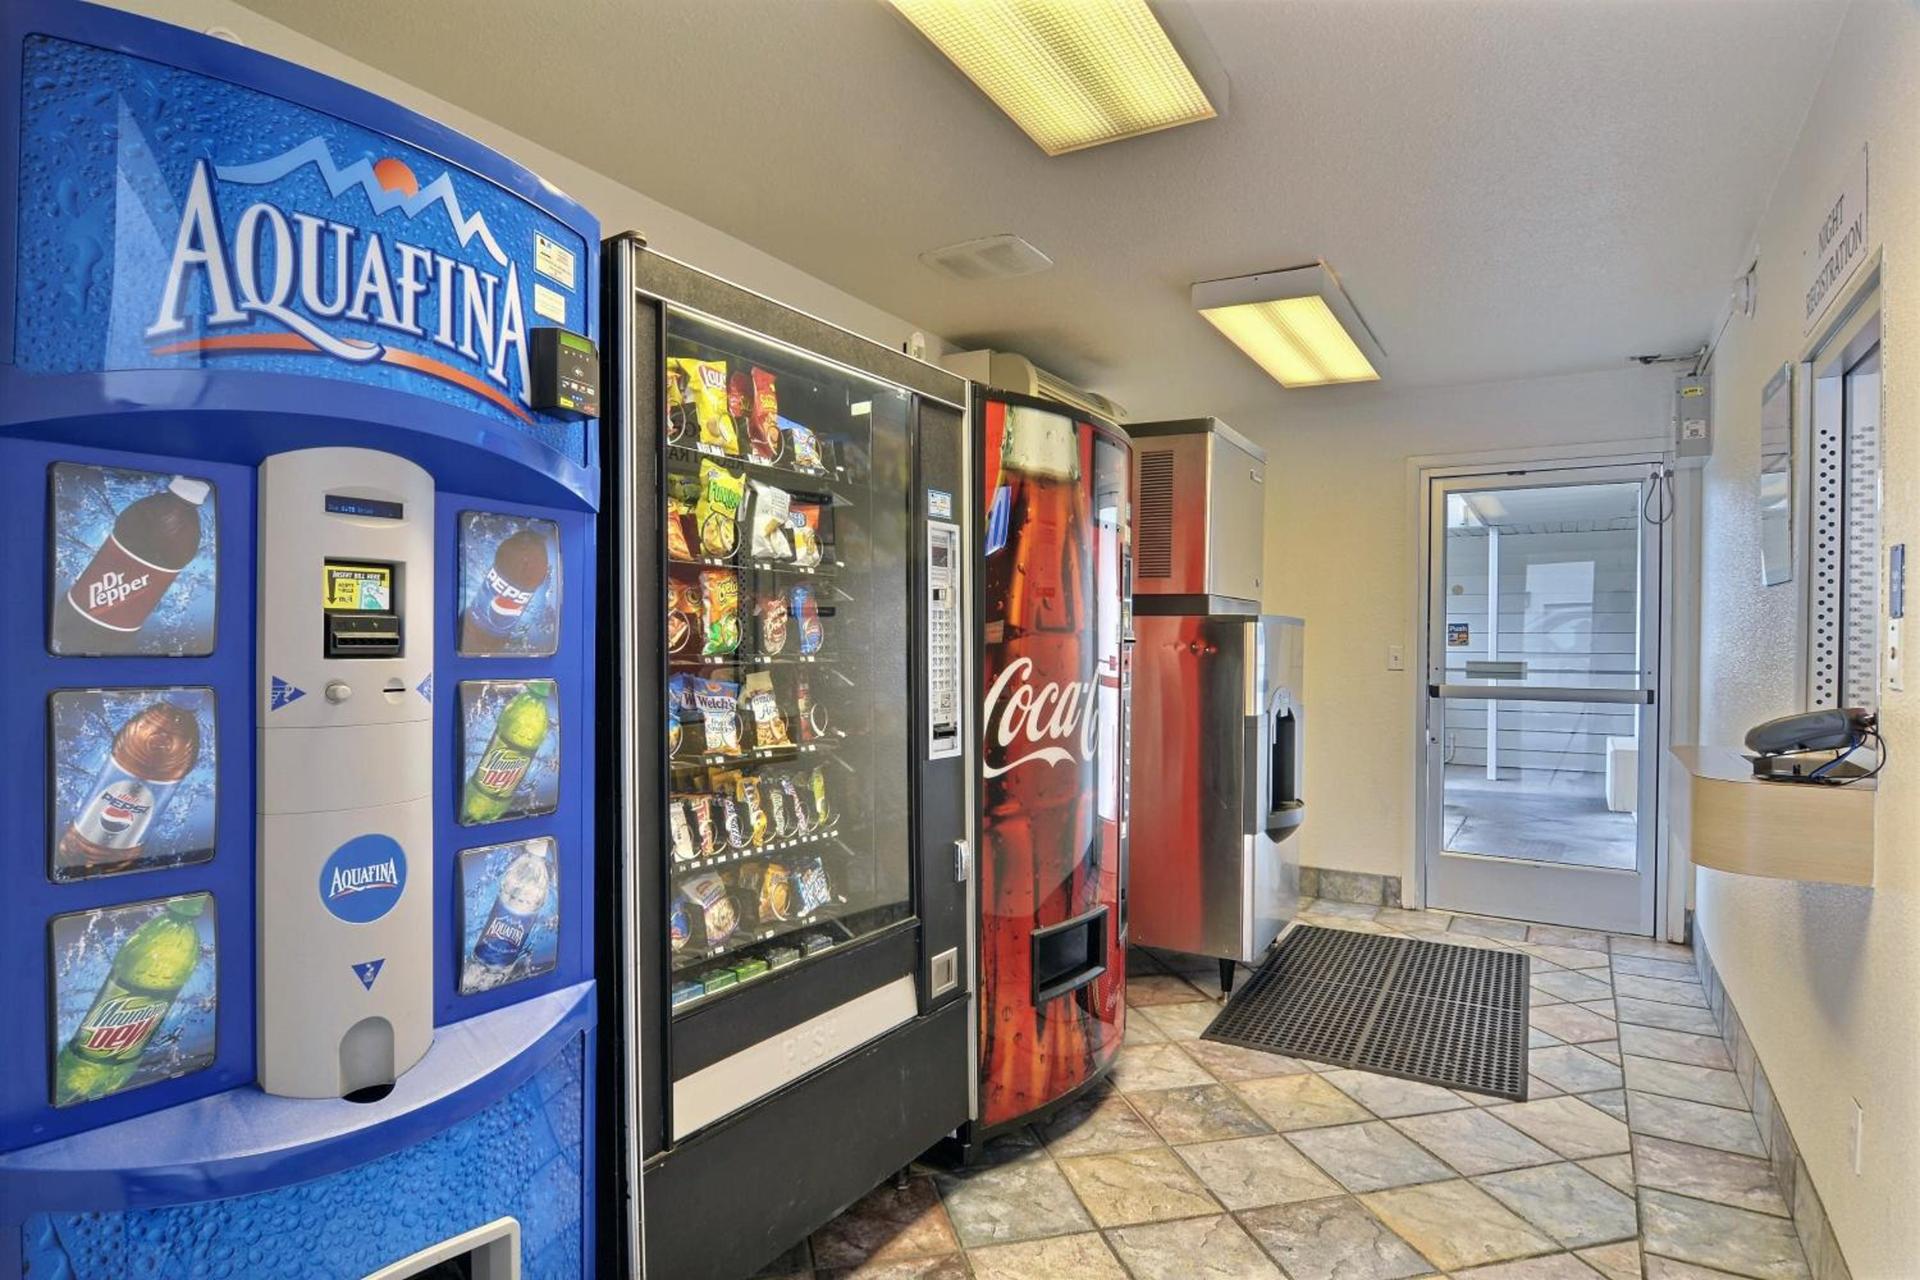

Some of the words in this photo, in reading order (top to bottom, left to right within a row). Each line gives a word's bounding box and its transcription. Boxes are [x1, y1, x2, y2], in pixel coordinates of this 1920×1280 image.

[1818, 193, 1844, 259] NIGHT
[145, 159, 531, 407] AQUAFINA
[89, 574, 149, 610] Pepper
[103, 571, 125, 591] Dr
[487, 567, 534, 604] PEPS
[697, 695, 735, 710] Welch's
[984, 657, 1100, 779] Coca-C
[328, 857, 398, 898] AQUAFINA
